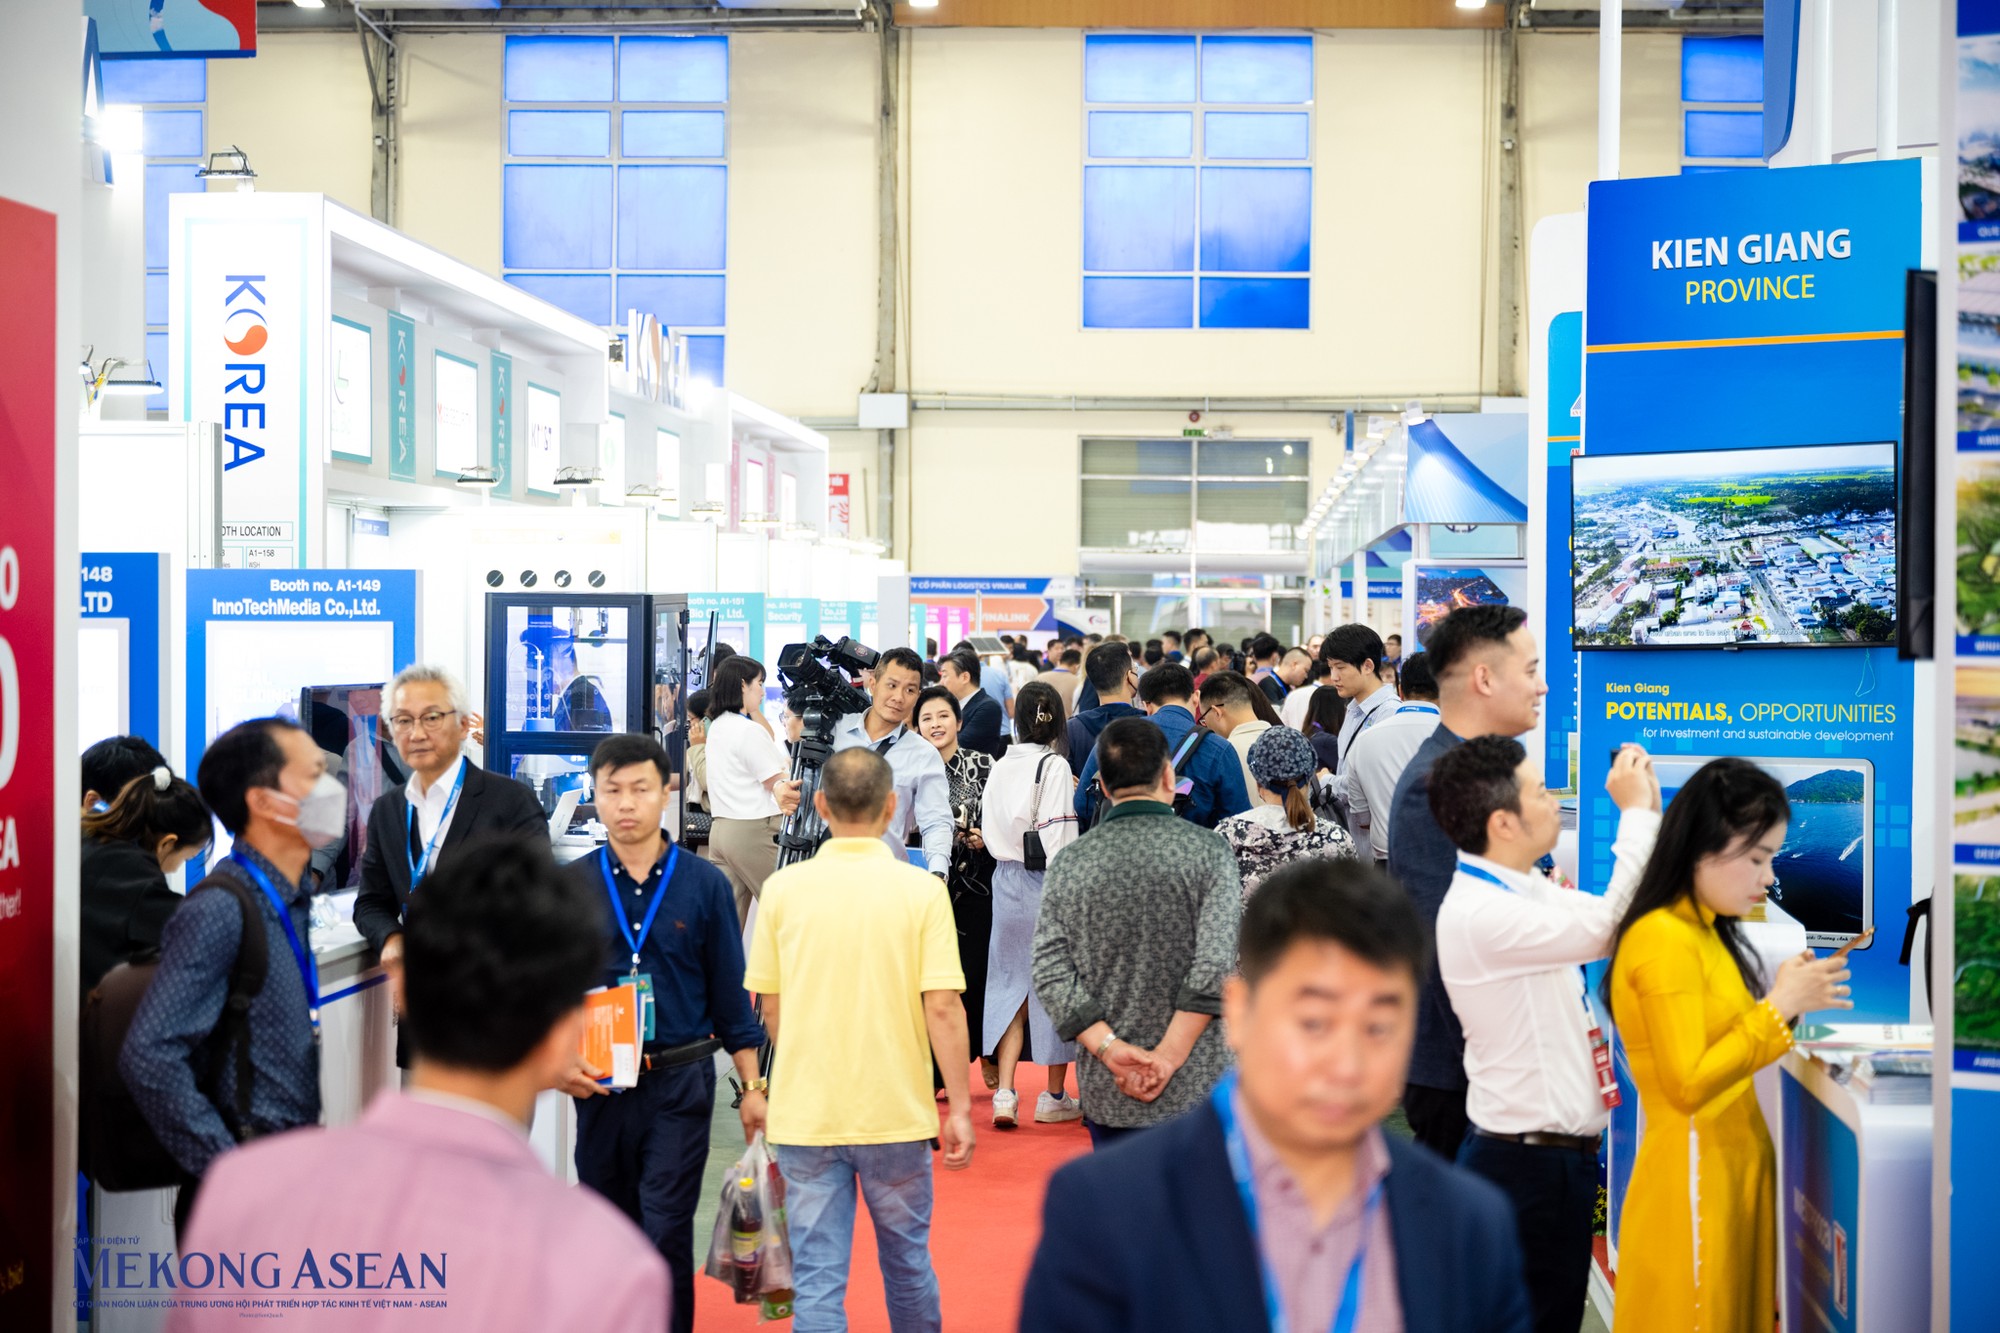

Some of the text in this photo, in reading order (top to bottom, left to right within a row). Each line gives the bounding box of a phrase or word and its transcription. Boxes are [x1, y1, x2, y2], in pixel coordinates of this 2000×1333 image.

[1652, 228, 1851, 270] KIEN GIANG
[1686, 274, 1815, 305] PROVINCE
[224, 275, 268, 472] KOREA
[398, 330, 407, 464] KOREA
[240, 526, 281, 537] LOCATION
[249, 549, 275, 557] A1-158
[270, 579, 381, 591] Booth no. A1-149
[952, 582, 990, 590] LOGISTICS
[992, 582, 1027, 590] VINALINK
[212, 598, 381, 618] InnoTechMedia Co.,Ltd.
[727, 608, 745, 618] Ltd.
[768, 611, 803, 623] Security
[1606, 683, 1670, 696] Kien Giang
[1606, 701, 1896, 724] POTENTIALS, OPPORTUNITIES
[1643, 727, 1894, 743] for investment and sustainable development
